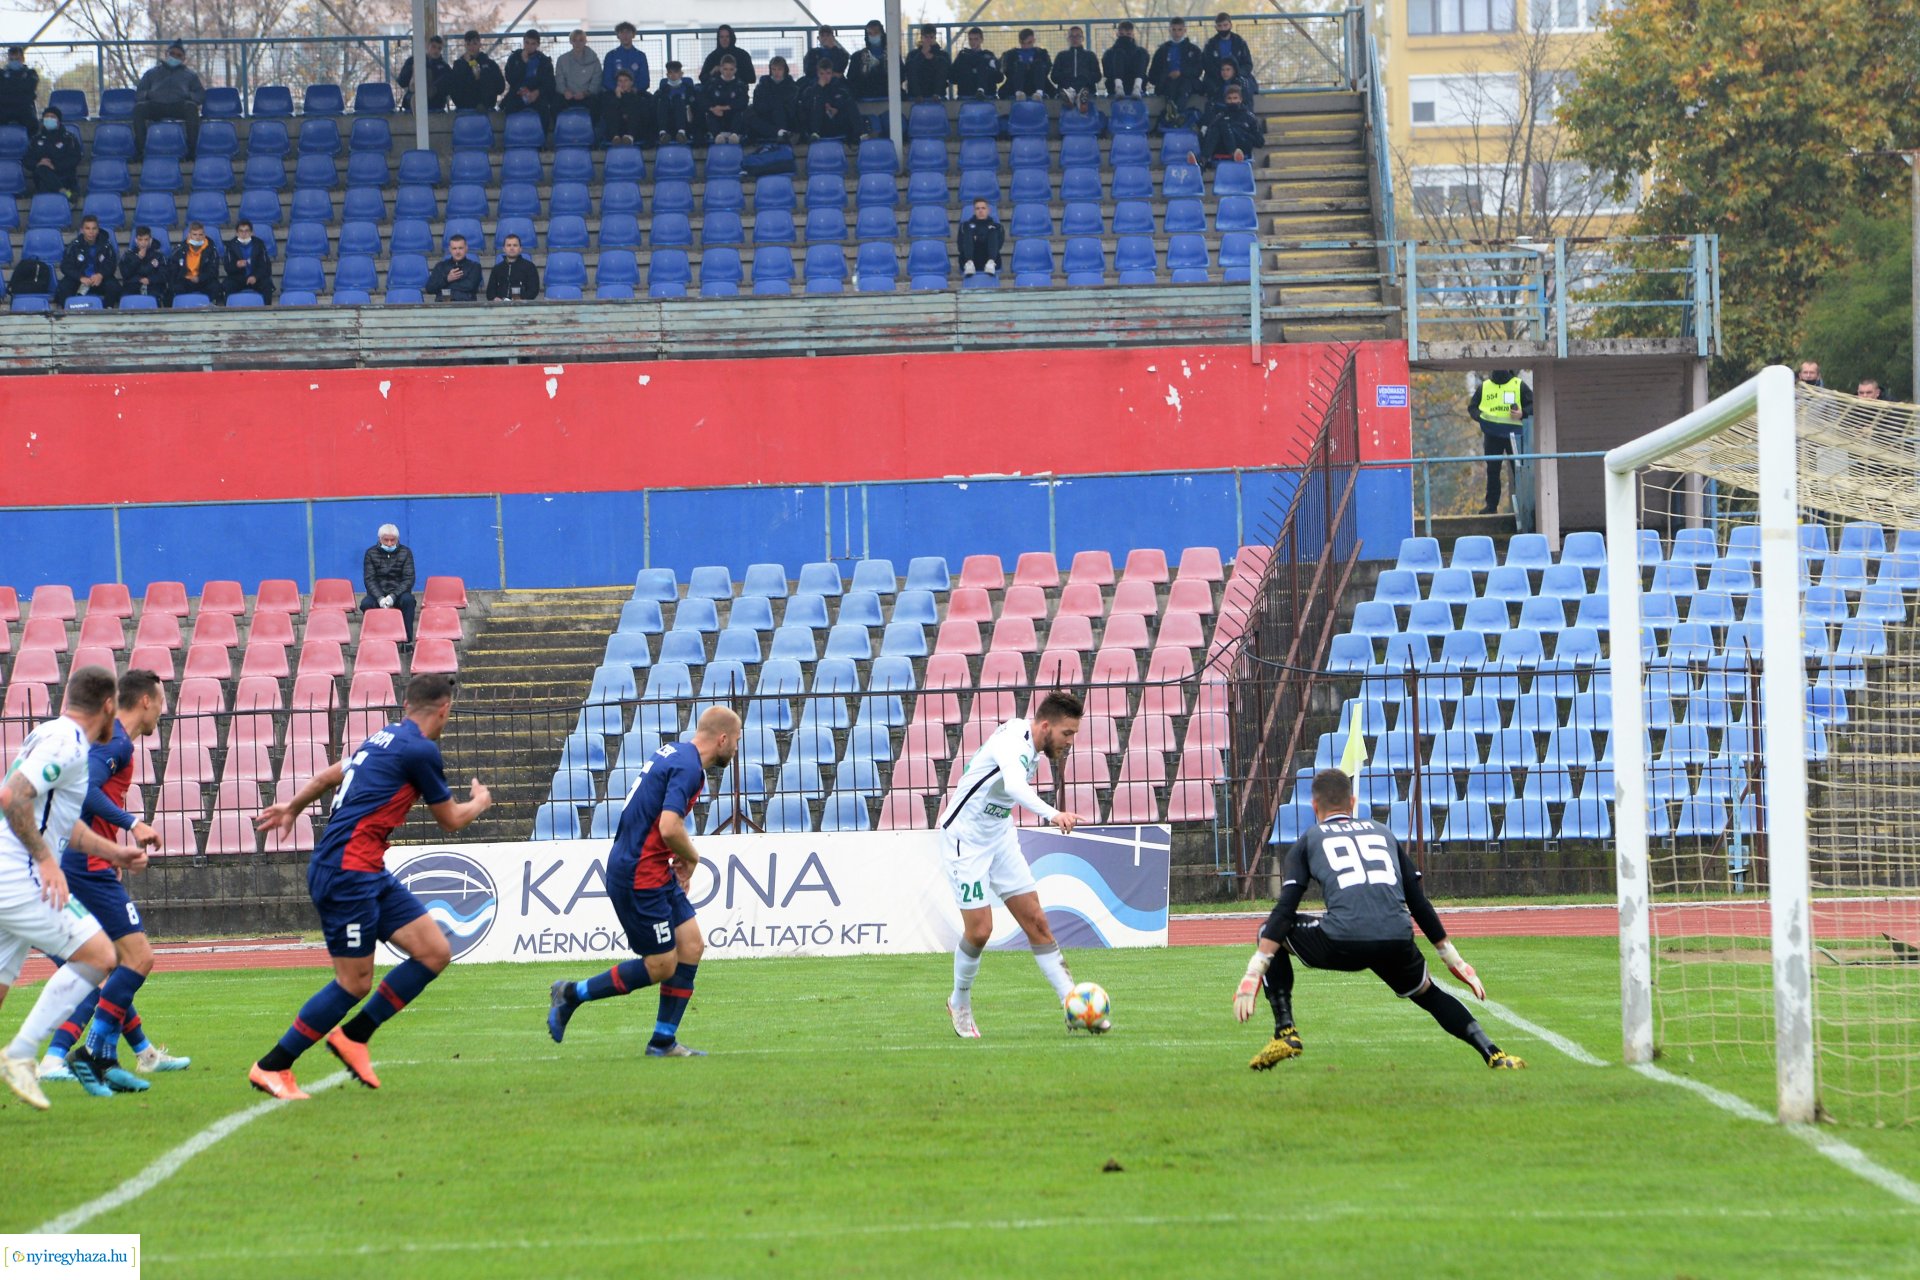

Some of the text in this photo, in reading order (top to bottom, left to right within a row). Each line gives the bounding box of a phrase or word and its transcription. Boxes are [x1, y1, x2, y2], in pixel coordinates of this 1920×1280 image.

[1322, 834, 1398, 890] 95
[520, 851, 841, 917] KAONA
[960, 881, 984, 902] 24
[125, 902, 140, 926] 8
[346, 923, 361, 948] 5
[652, 920, 672, 945] 15
[840, 923, 889, 946] KFT.
